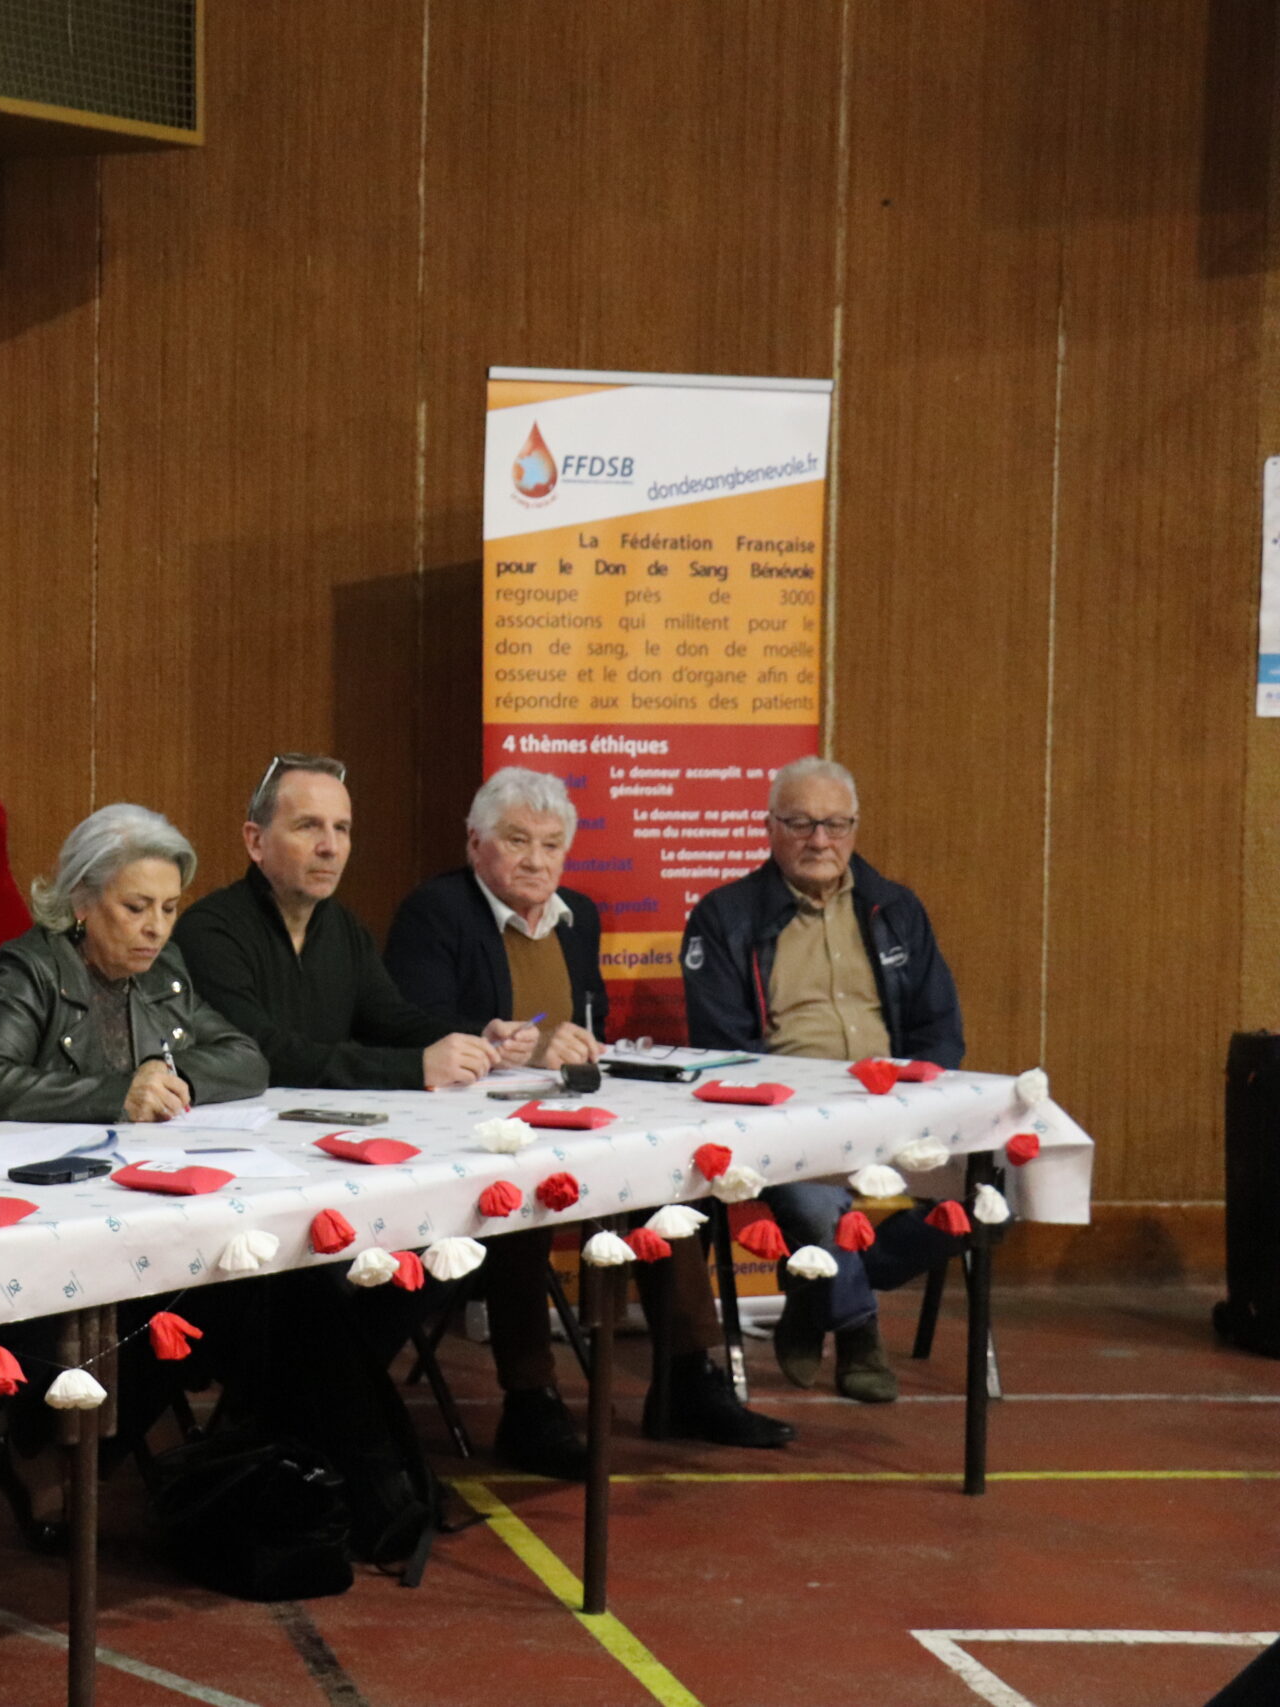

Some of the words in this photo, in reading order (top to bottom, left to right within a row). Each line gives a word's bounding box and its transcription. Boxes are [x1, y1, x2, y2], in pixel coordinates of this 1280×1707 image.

[561, 454, 635, 478] FFDSB
[647, 452, 820, 502] dondesangbenevole.fr
[578, 533, 600, 549] La
[621, 532, 714, 551] Fédération
[736, 535, 816, 557] Française
[496, 560, 537, 578] pour
[559, 559, 573, 576] le
[595, 560, 627, 577] Don
[647, 560, 669, 577] de
[689, 561, 730, 581] Sang
[750, 561, 816, 580] Bénévole
[496, 587, 579, 606] regroupe
[624, 586, 662, 607] près
[708, 589, 732, 605] de
[779, 590, 816, 606] 3000
[495, 612, 604, 629] associations
[618, 614, 647, 632] qui
[664, 614, 730, 631] militent
[747, 617, 788, 634] pour
[495, 638, 533, 656] don
[548, 638, 572, 656] de
[645, 639, 661, 657] le
[676, 640, 710, 657] don
[724, 640, 748, 657] de
[495, 667, 567, 682] osseuse
[577, 666, 595, 682] et
[602, 665, 618, 682] le
[627, 665, 662, 683] don
[757, 666, 789, 684] afin
[796, 667, 814, 684] de
[495, 692, 580, 712] répondre
[589, 694, 620, 708] aux
[631, 692, 697, 709] besoins
[708, 693, 739, 709] des
[752, 694, 814, 713] patients
[502, 736, 516, 752] 4
[519, 735, 587, 753] thèmes
[589, 735, 669, 757] éthiques
[610, 766, 625, 779] Le
[629, 766, 681, 779] donneur
[684, 766, 742, 781] accomplit
[746, 768, 764, 779] un
[609, 783, 674, 799] générosité
[633, 808, 648, 821] Le
[650, 808, 700, 821] donneur
[704, 810, 719, 821] ne
[721, 810, 749, 823] peut
[633, 828, 661, 838] nom
[663, 826, 679, 838] du
[681, 828, 731, 838] receveur
[732, 827, 746, 838] et
[660, 849, 675, 861] Le
[677, 848, 726, 861] donneur
[727, 850, 743, 861] ne
[660, 866, 720, 879] contrainte
